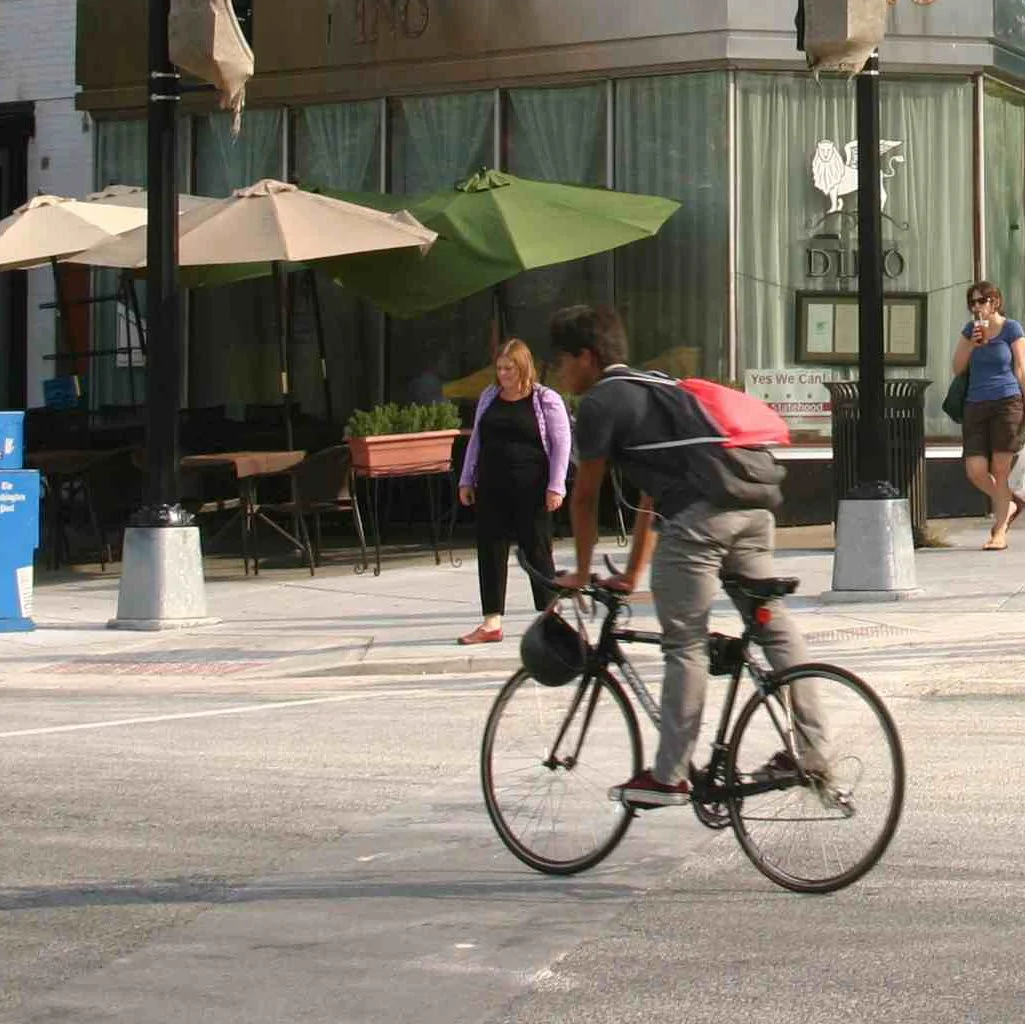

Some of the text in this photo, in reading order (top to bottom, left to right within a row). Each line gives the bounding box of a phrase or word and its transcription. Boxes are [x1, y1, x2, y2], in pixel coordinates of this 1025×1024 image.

[806, 246, 905, 278] DIO
[751, 374, 773, 385] Yes
[775, 374, 795, 385] We
